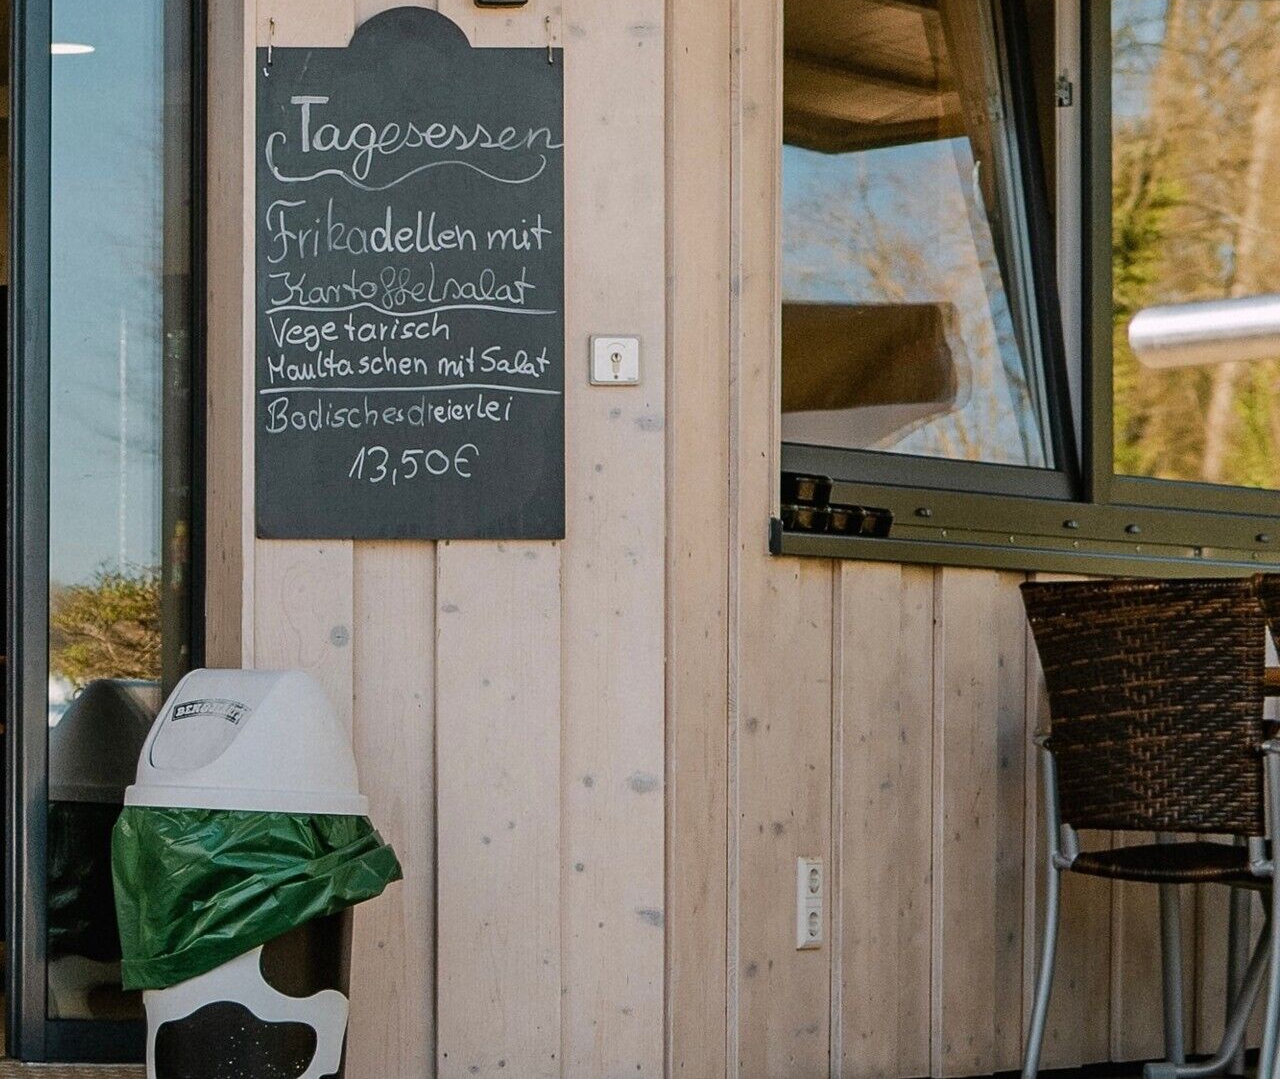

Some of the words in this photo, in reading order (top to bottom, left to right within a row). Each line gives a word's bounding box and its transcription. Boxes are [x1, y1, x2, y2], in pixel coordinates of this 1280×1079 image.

[290, 95, 565, 180] Tagesessen
[267, 197, 477, 264] Frikadellen
[486, 212, 553, 252] mit
[268, 261, 536, 307] Kartoffelsalat
[269, 312, 450, 352] Vegetarisch
[267, 346, 428, 384] Maultaschen
[438, 346, 476, 378] mit
[480, 345, 551, 378] Salat
[348, 442, 480, 486] 13,50€
